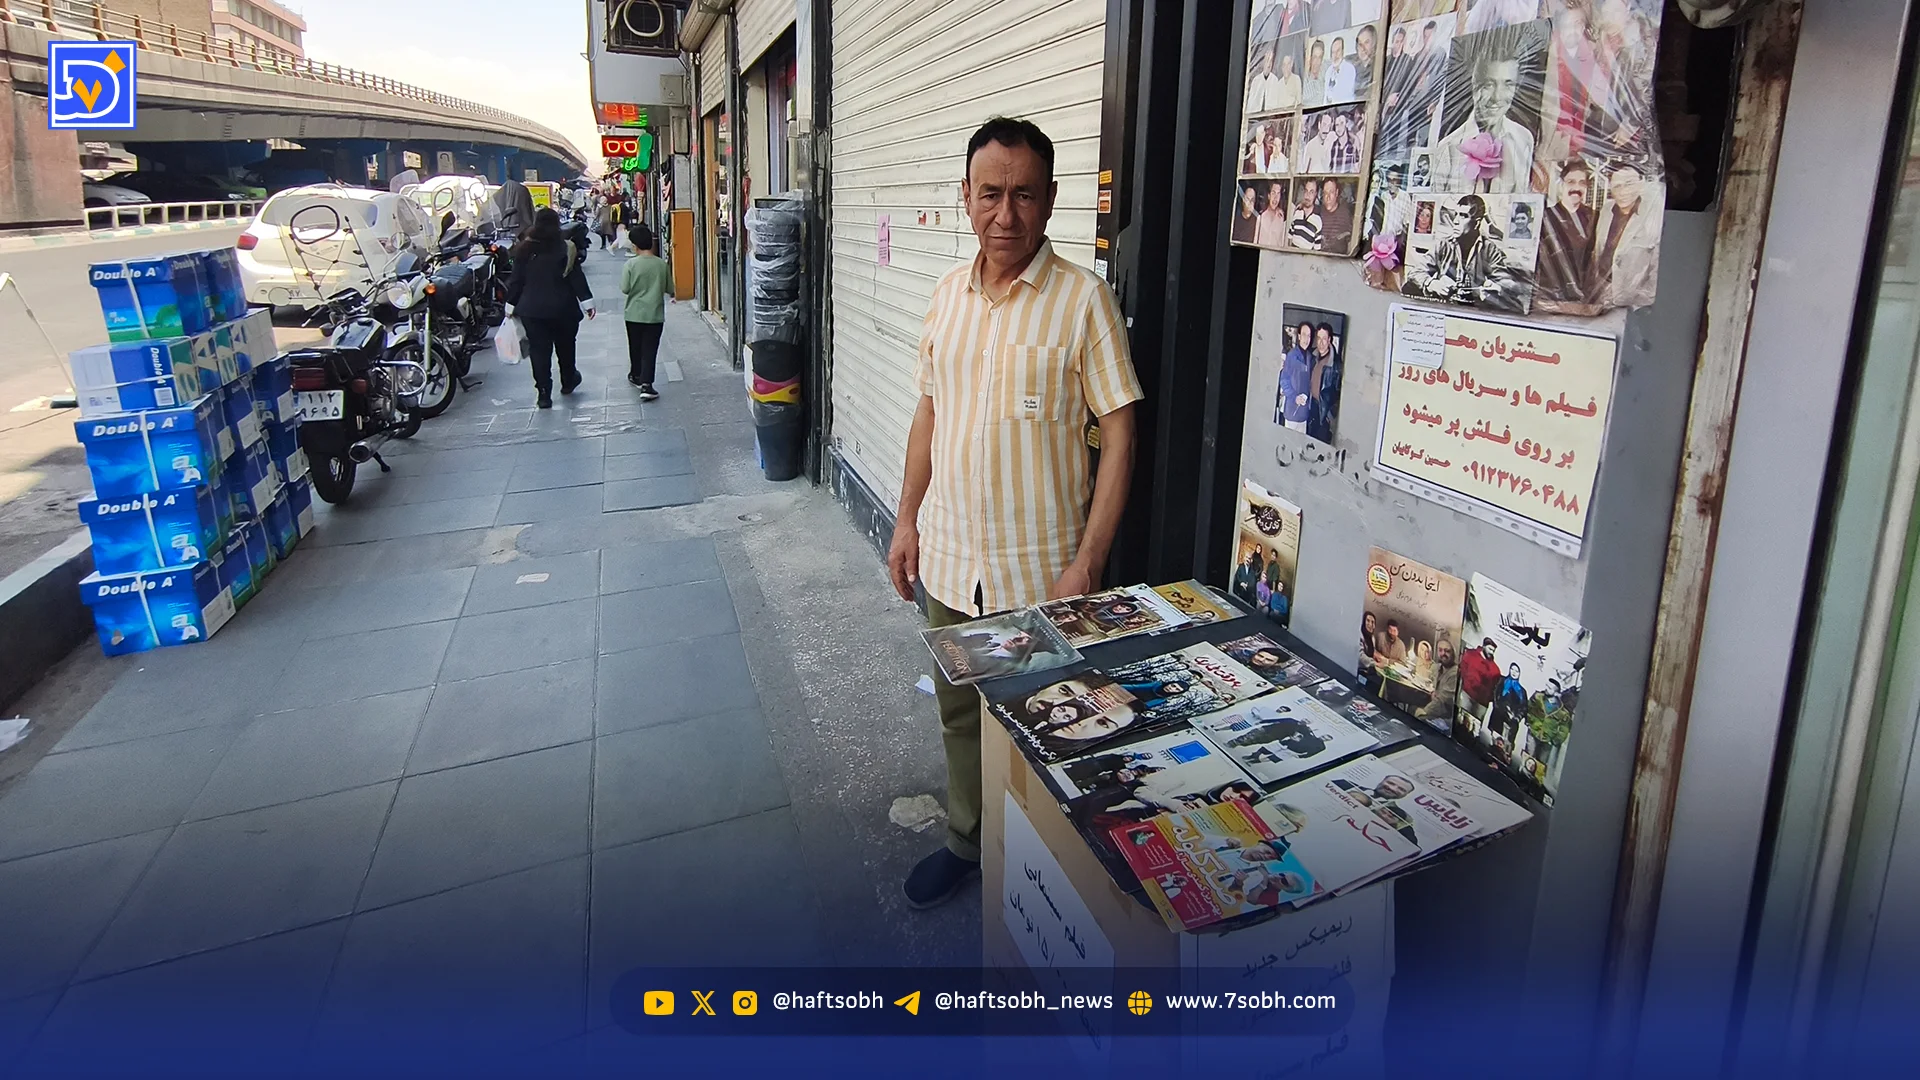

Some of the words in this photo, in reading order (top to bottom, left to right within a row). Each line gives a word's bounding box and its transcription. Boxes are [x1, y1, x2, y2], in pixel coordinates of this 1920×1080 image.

[94, 269, 141, 280] Double
[145, 267, 156, 277] A
[151, 347, 163, 375] Double
[1481, 336, 1561, 365] مشتریان
[1398, 363, 1420, 382] روز
[1423, 366, 1450, 385] های
[1453, 370, 1507, 398] سریال
[1510, 389, 1520, 406] و
[1525, 384, 1542, 406] ها
[1545, 392, 1598, 418] فیلم
[161, 417, 174, 429] A
[1402, 402, 1443, 427] میشود
[1444, 418, 1461, 437] پر
[1463, 419, 1511, 445] فلش
[1424, 452, 1451, 468] حسین
[1514, 438, 1551, 463] روی
[1555, 449, 1575, 469] بر
[164, 495, 176, 506] A
[1462, 460, 1580, 516] ۰۹۱۲۳۷۶۰۴۸۸
[1390, 563, 1406, 576] من
[1401, 570, 1423, 587] بدون
[98, 580, 157, 596] Double
[161, 577, 173, 588] A
[1424, 576, 1440, 595] اینجا
[1324, 782, 1358, 810] Verdict
[1414, 794, 1474, 829] زاپاس
[1332, 813, 1392, 852] حکم
[1024, 861, 1062, 923] سینمایی
[1009, 890, 1034, 934] تومان
[1065, 924, 1086, 960] فیلم
[1285, 916, 1353, 960] ریمیکس
[1242, 953, 1278, 980] جدید
